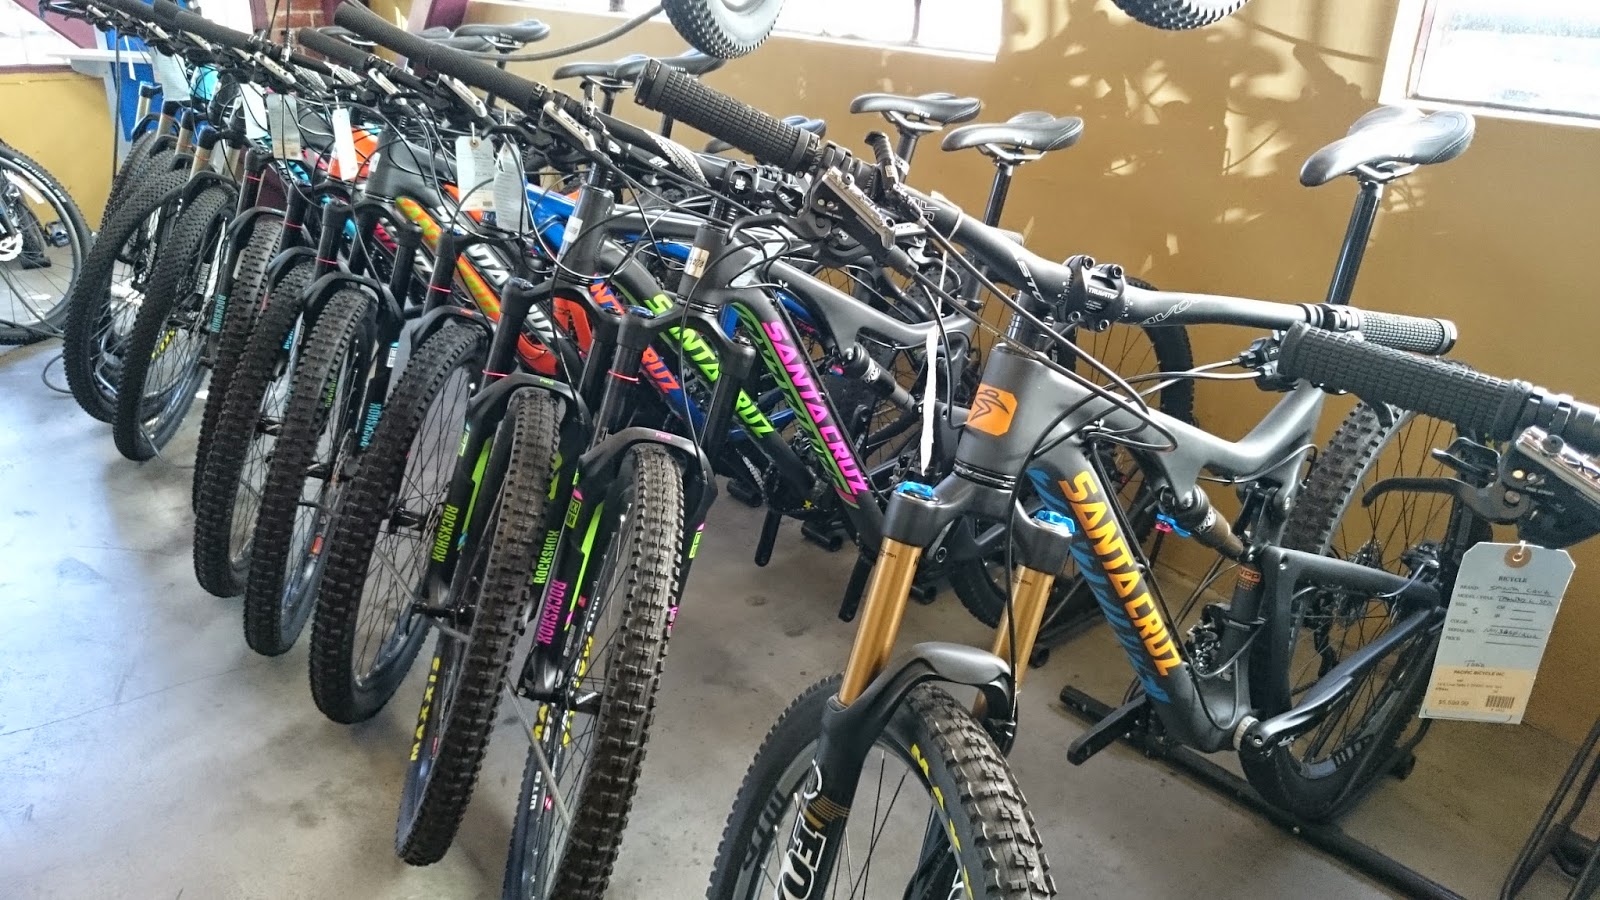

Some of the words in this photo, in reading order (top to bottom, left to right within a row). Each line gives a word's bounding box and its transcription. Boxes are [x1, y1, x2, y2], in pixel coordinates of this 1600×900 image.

[762, 321, 829, 424] SANTA
[819, 426, 869, 496] CRUZ
[431, 504, 460, 563] ROCKSHOX
[533, 529, 561, 584] ROCKSHOX
[1058, 470, 1141, 599] SANTA
[1125, 594, 1183, 677] CRUZ
[537, 579, 568, 645] ROCKSHOX
